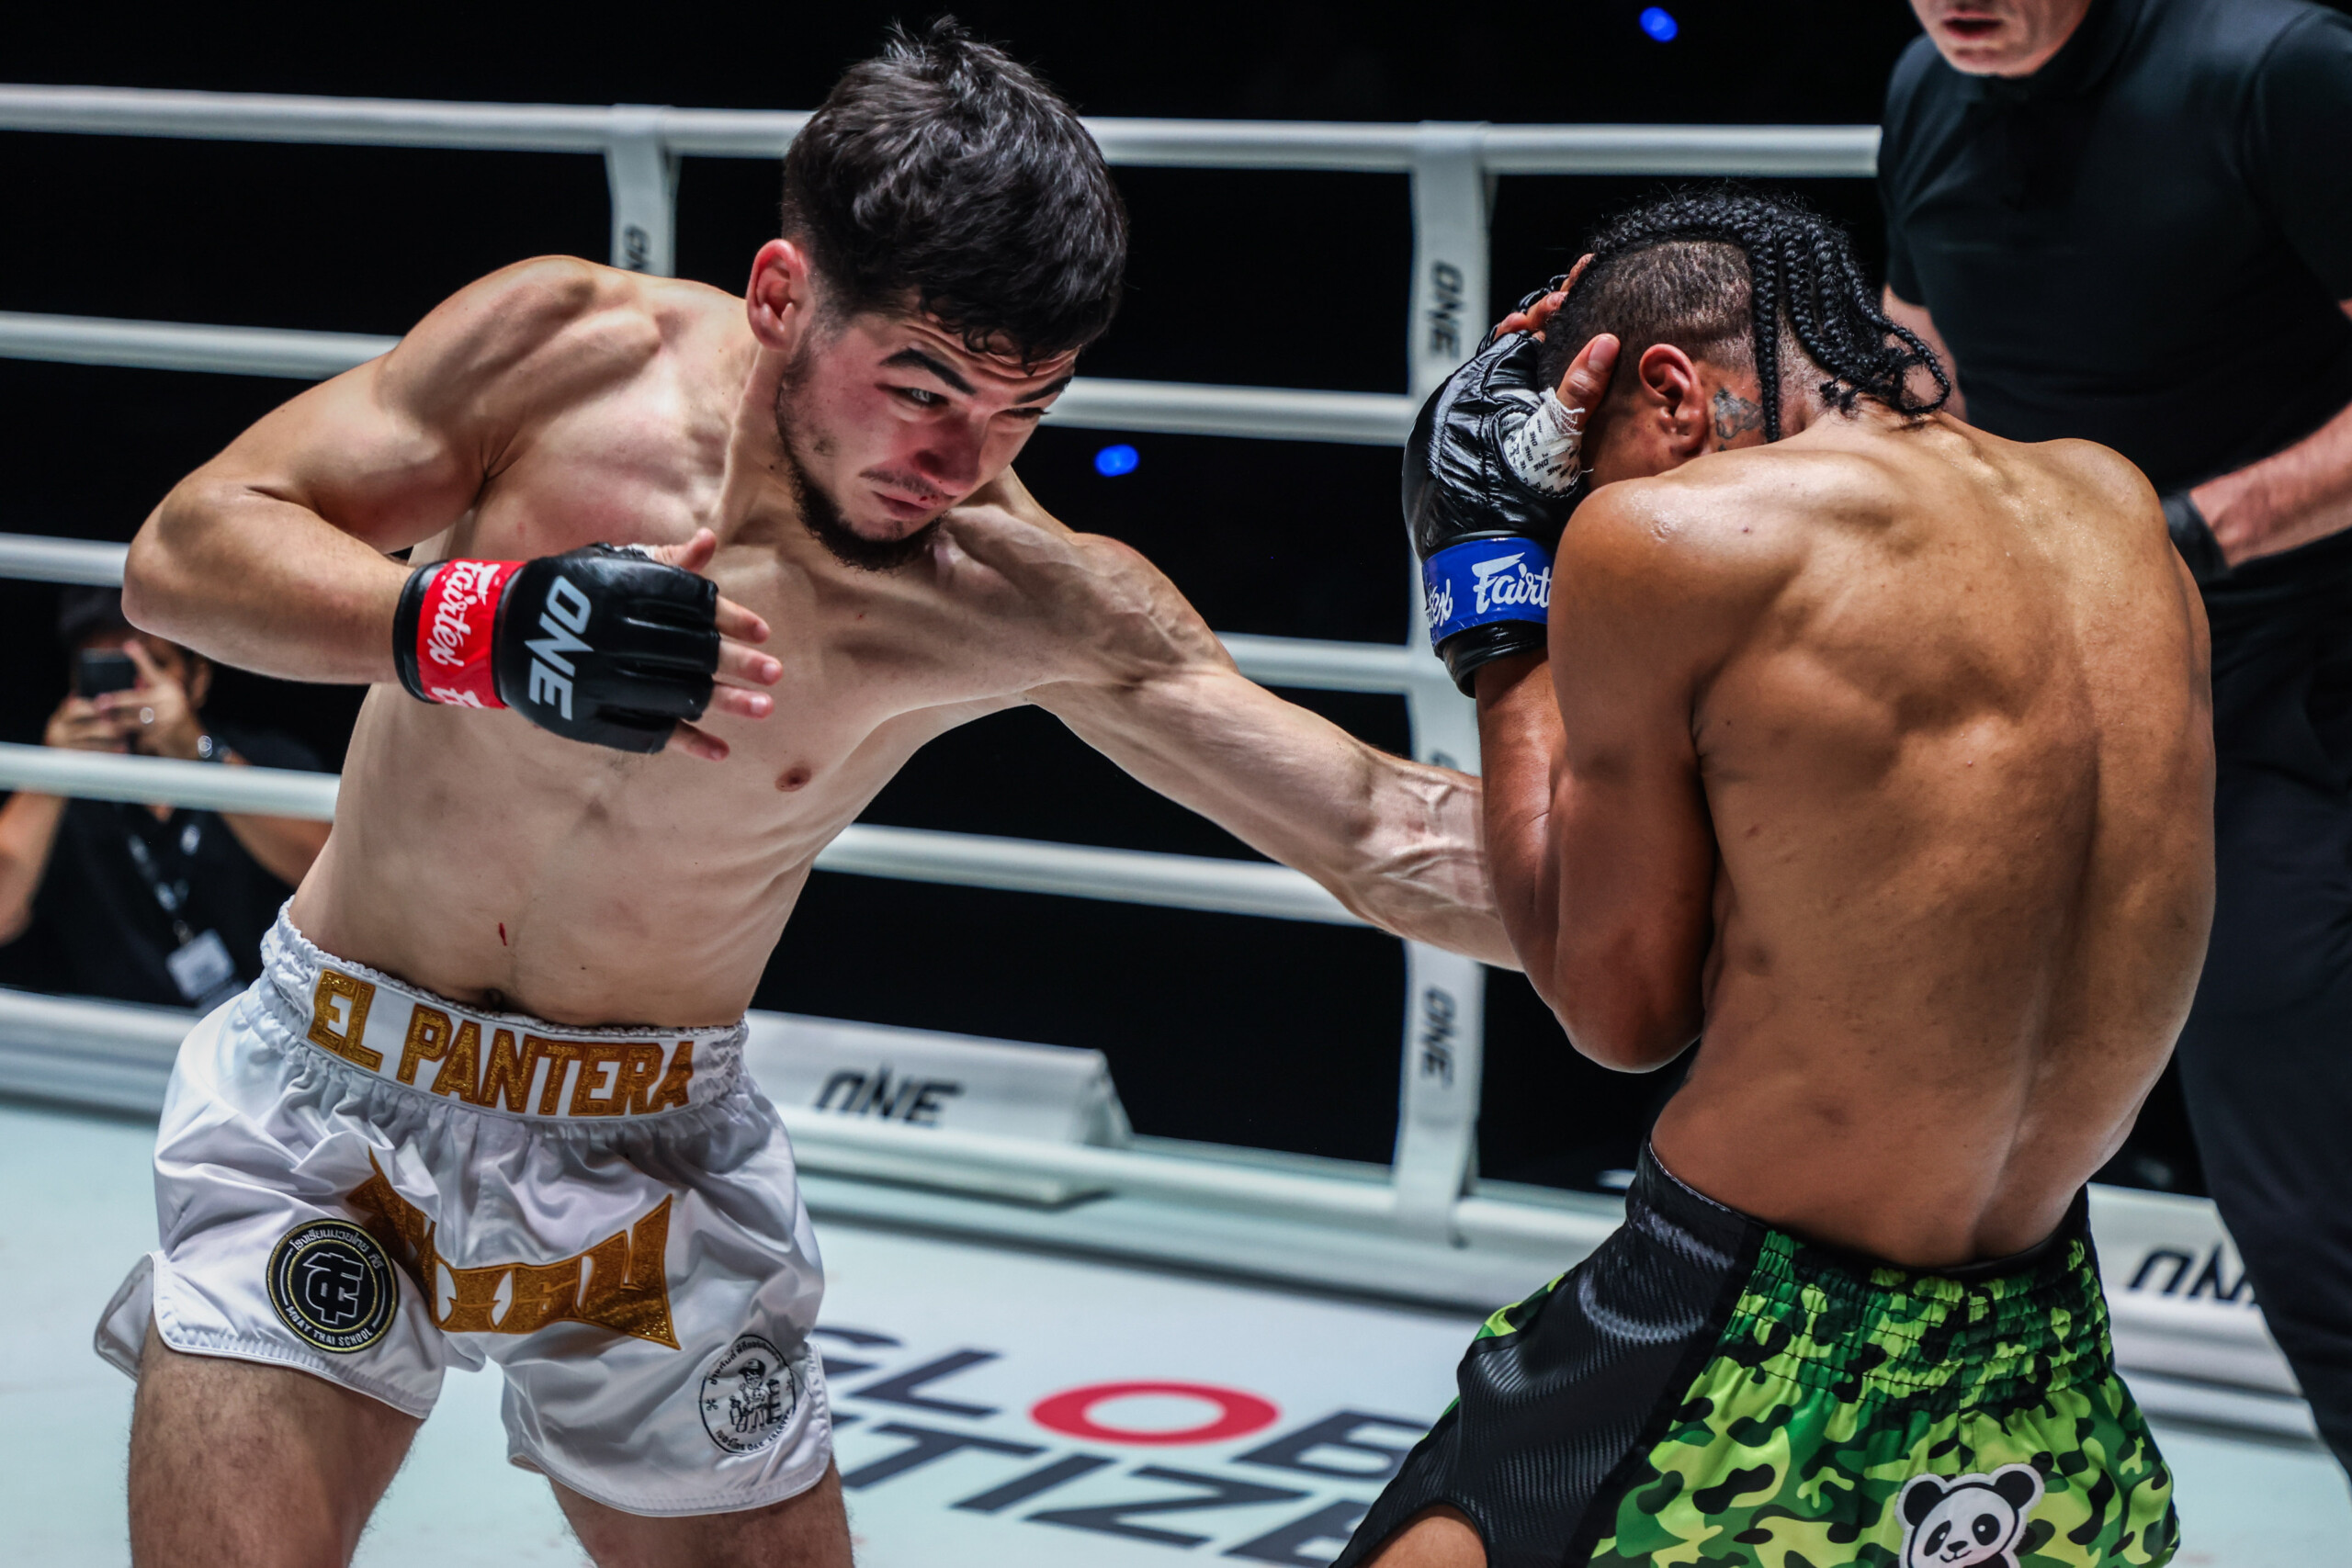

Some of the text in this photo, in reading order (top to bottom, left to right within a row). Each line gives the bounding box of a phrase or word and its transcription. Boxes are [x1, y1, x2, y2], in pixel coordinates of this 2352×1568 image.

[1430, 259, 1463, 359] ONE
[1524, 445, 1533, 461] ONE
[1530, 431, 1538, 446] ONE
[1533, 458, 1549, 472] ONE
[427, 561, 501, 667] Fairtex
[1471, 552, 1553, 615] Fairt
[525, 575, 594, 720] ONE
[307, 968, 694, 1116] EL PANTERA
[1420, 986, 1459, 1090] ONE
[816, 1061, 964, 1127] ONE
[2127, 1243, 2255, 1307] ON
[286, 1305, 373, 1347] MUAY THAI SCHOOL
